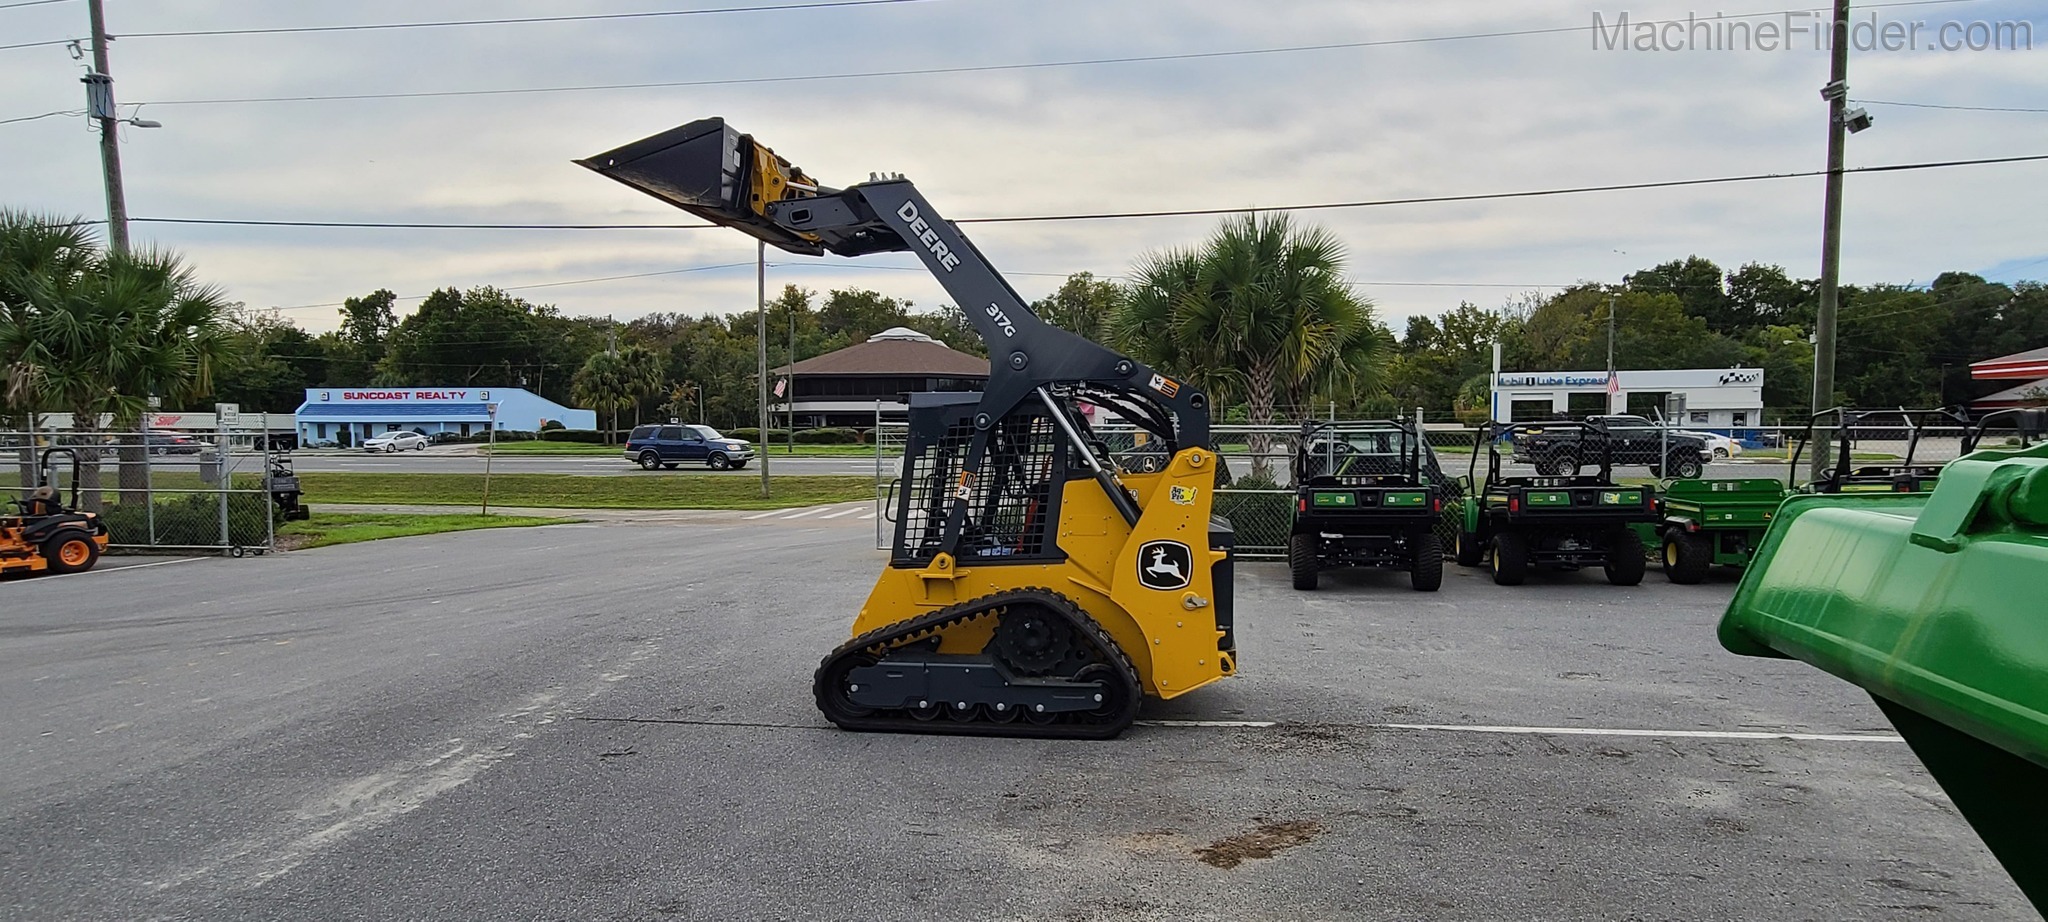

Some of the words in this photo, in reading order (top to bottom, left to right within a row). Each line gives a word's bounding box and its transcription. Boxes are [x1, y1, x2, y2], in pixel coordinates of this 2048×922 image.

[897, 200, 961, 273] DEERE
[985, 302, 1017, 338] 317G
[1537, 376, 1563, 386] Lube
[343, 392, 410, 400] SUNCOAST
[416, 391, 467, 400] REALTY
